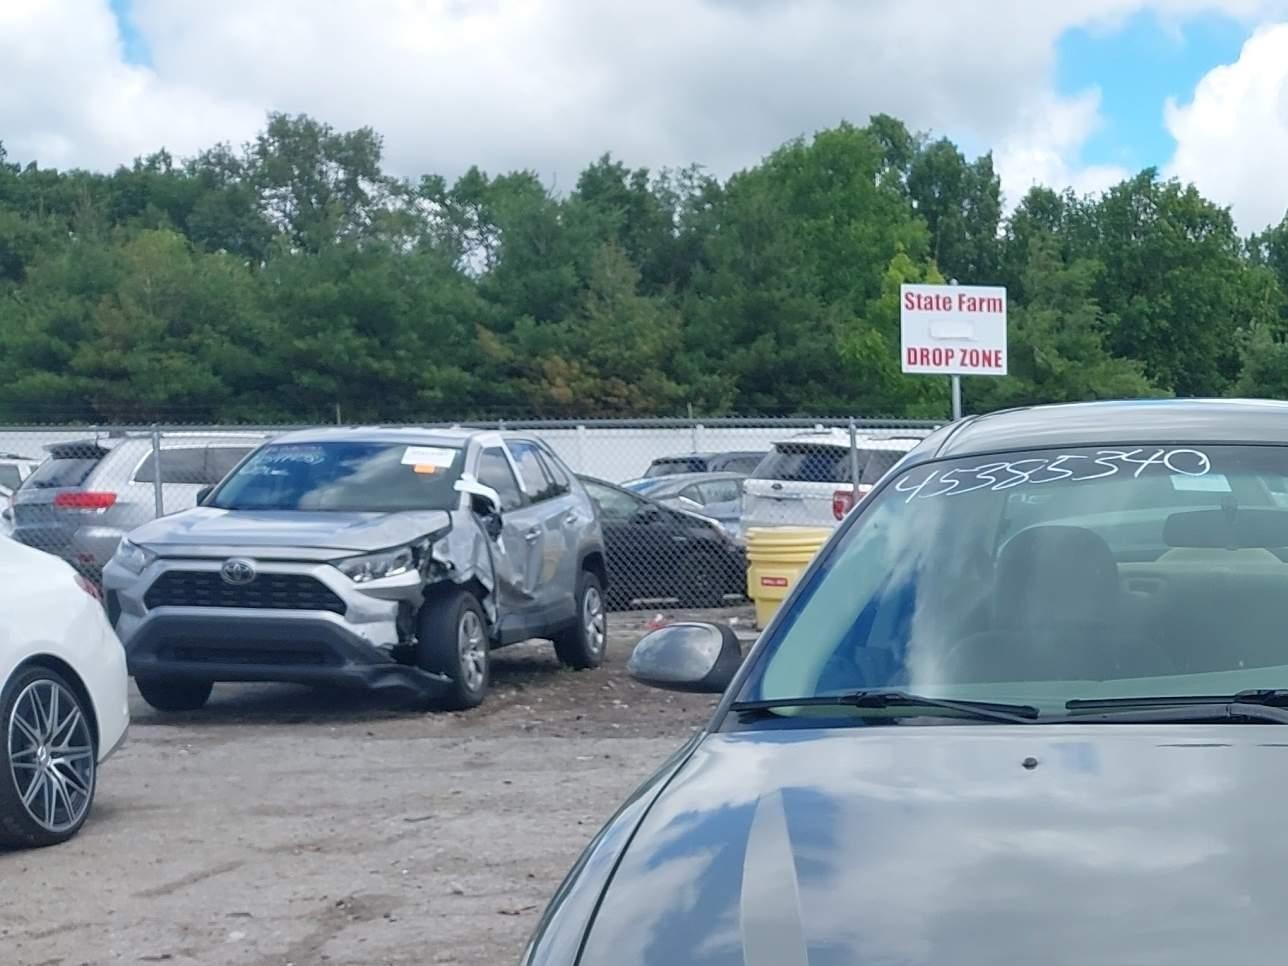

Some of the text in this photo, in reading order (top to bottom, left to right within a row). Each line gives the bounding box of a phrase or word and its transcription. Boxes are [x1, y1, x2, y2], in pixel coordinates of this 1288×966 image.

[904, 292, 1003, 313] State Farm
[907, 347, 1003, 368] DROP ZONE
[895, 448, 1212, 504] 45385340
